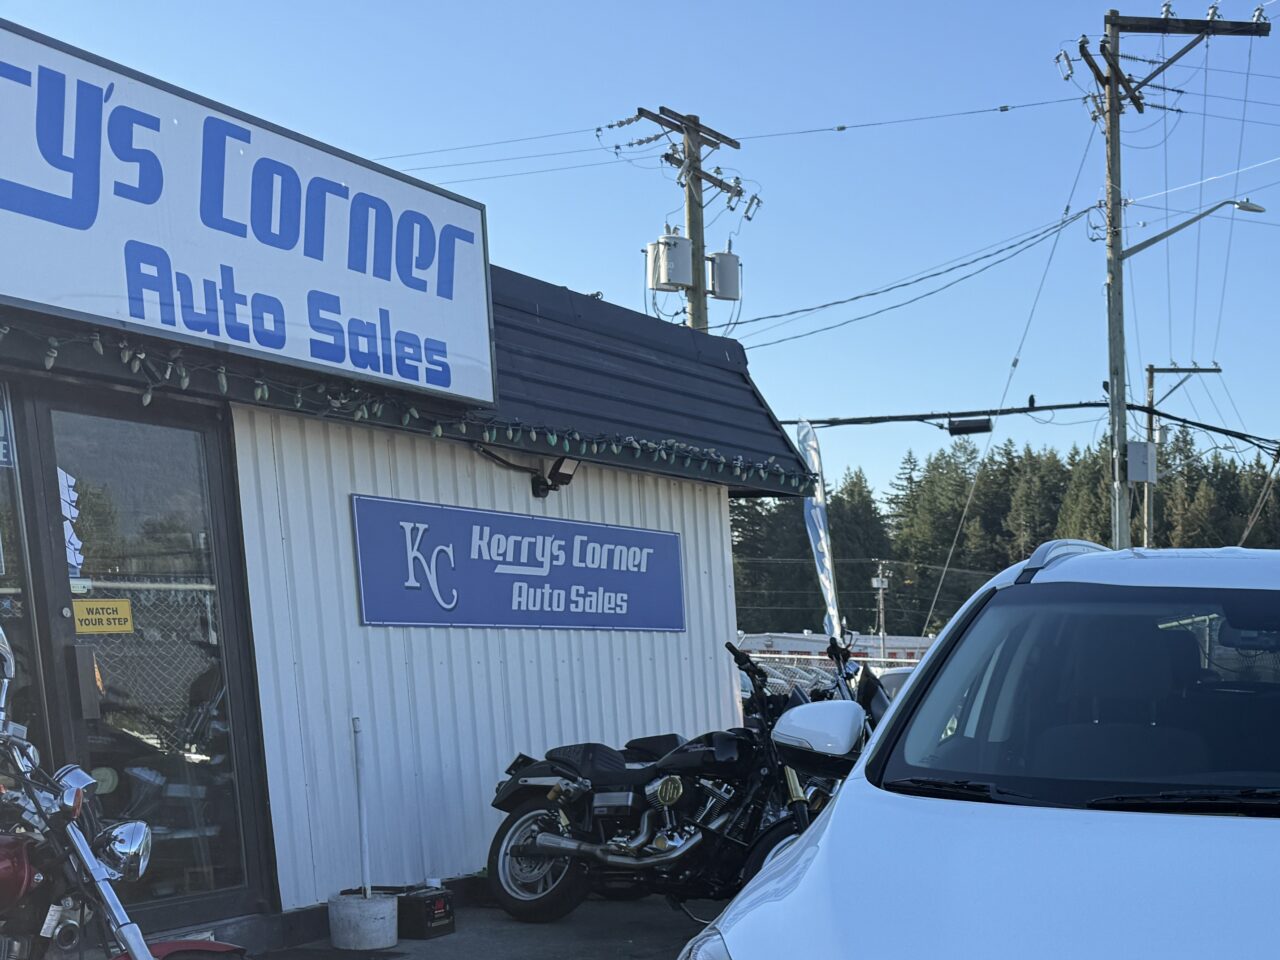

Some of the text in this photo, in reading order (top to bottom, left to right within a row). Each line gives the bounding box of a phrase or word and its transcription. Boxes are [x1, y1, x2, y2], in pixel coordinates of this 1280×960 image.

[200, 116, 475, 301] Corner
[124, 239, 451, 388] Auto Sales
[470, 524, 654, 577] Kerry's Corner
[86, 606, 118, 616] WATCH
[511, 581, 628, 614] Auto Sales
[78, 617, 129, 627] YOUR STEP
